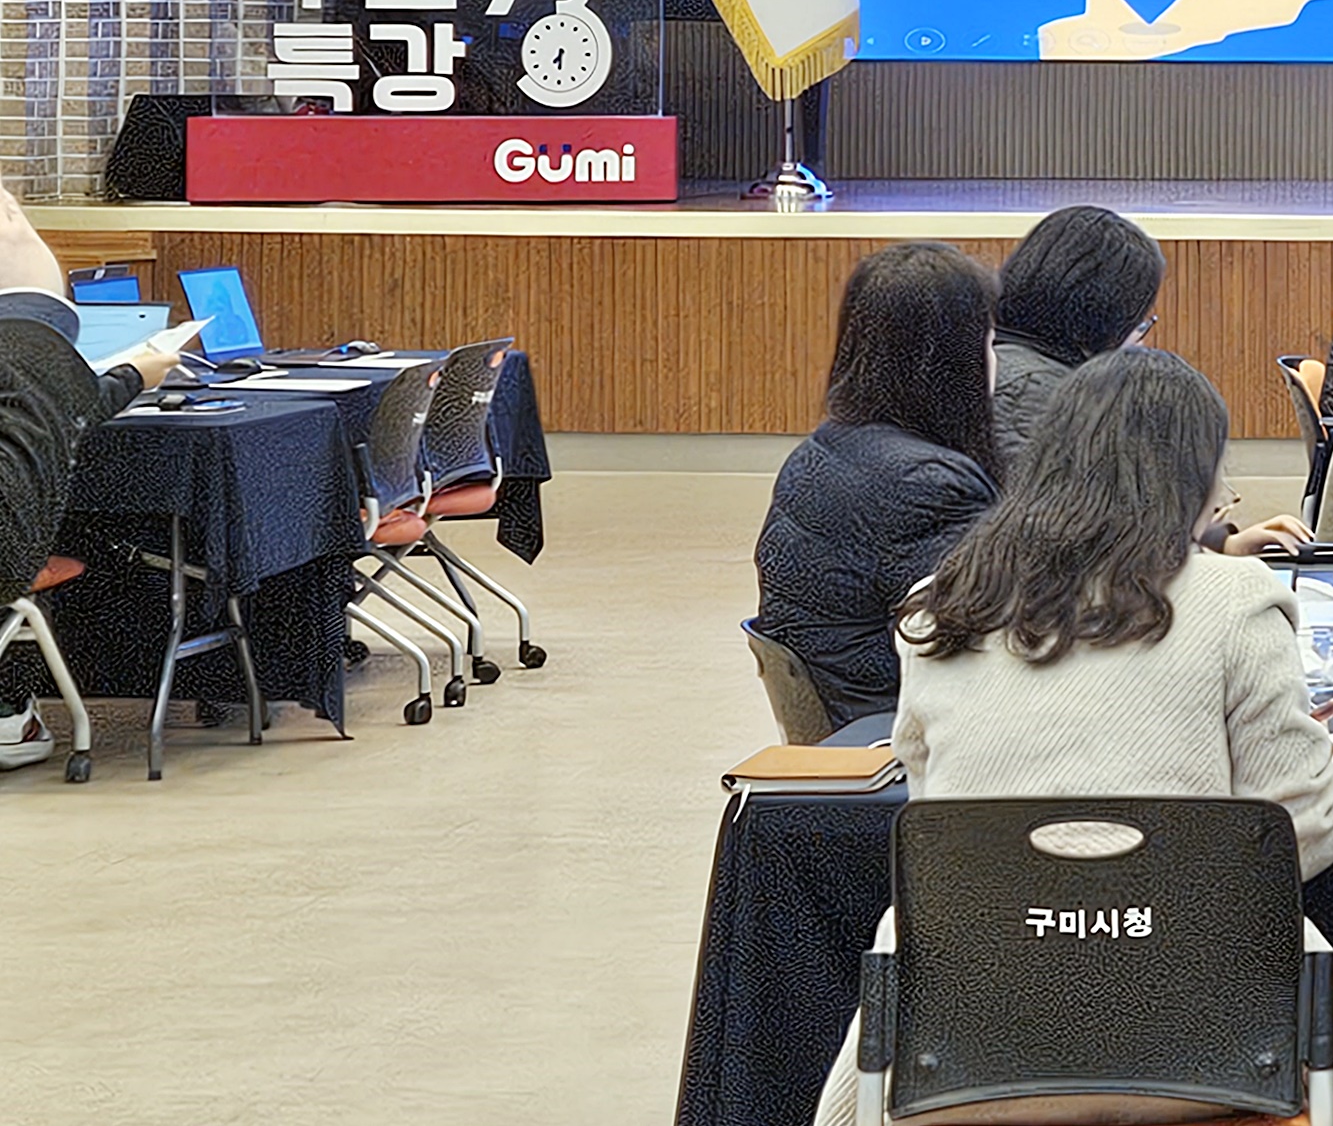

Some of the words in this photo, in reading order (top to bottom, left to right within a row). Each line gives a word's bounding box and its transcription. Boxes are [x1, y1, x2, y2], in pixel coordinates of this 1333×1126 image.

[267, 23, 466, 113] 특강
[493, 137, 636, 184] Gumi
[1025, 906, 1153, 939] 구미시청
